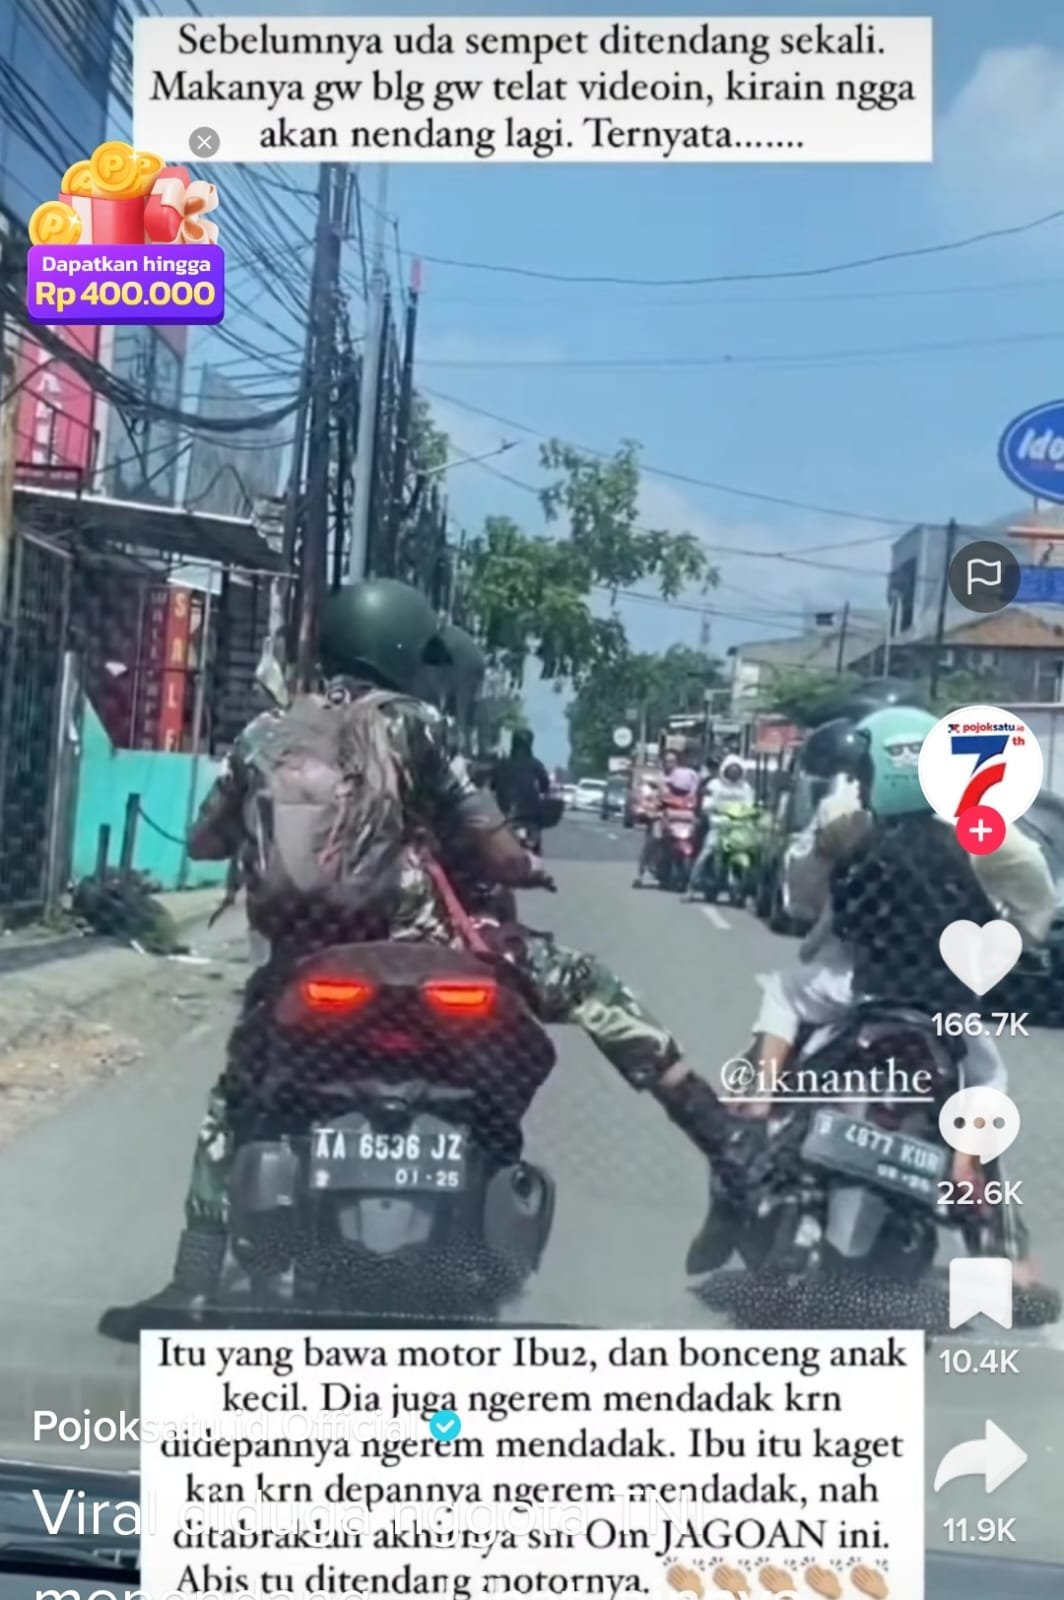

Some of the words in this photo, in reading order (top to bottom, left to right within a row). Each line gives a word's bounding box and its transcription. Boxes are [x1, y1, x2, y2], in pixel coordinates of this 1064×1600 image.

[315, 1131, 347, 1160] AA
[359, 1133, 421, 1161] 6536
[430, 1133, 462, 1161] JZ
